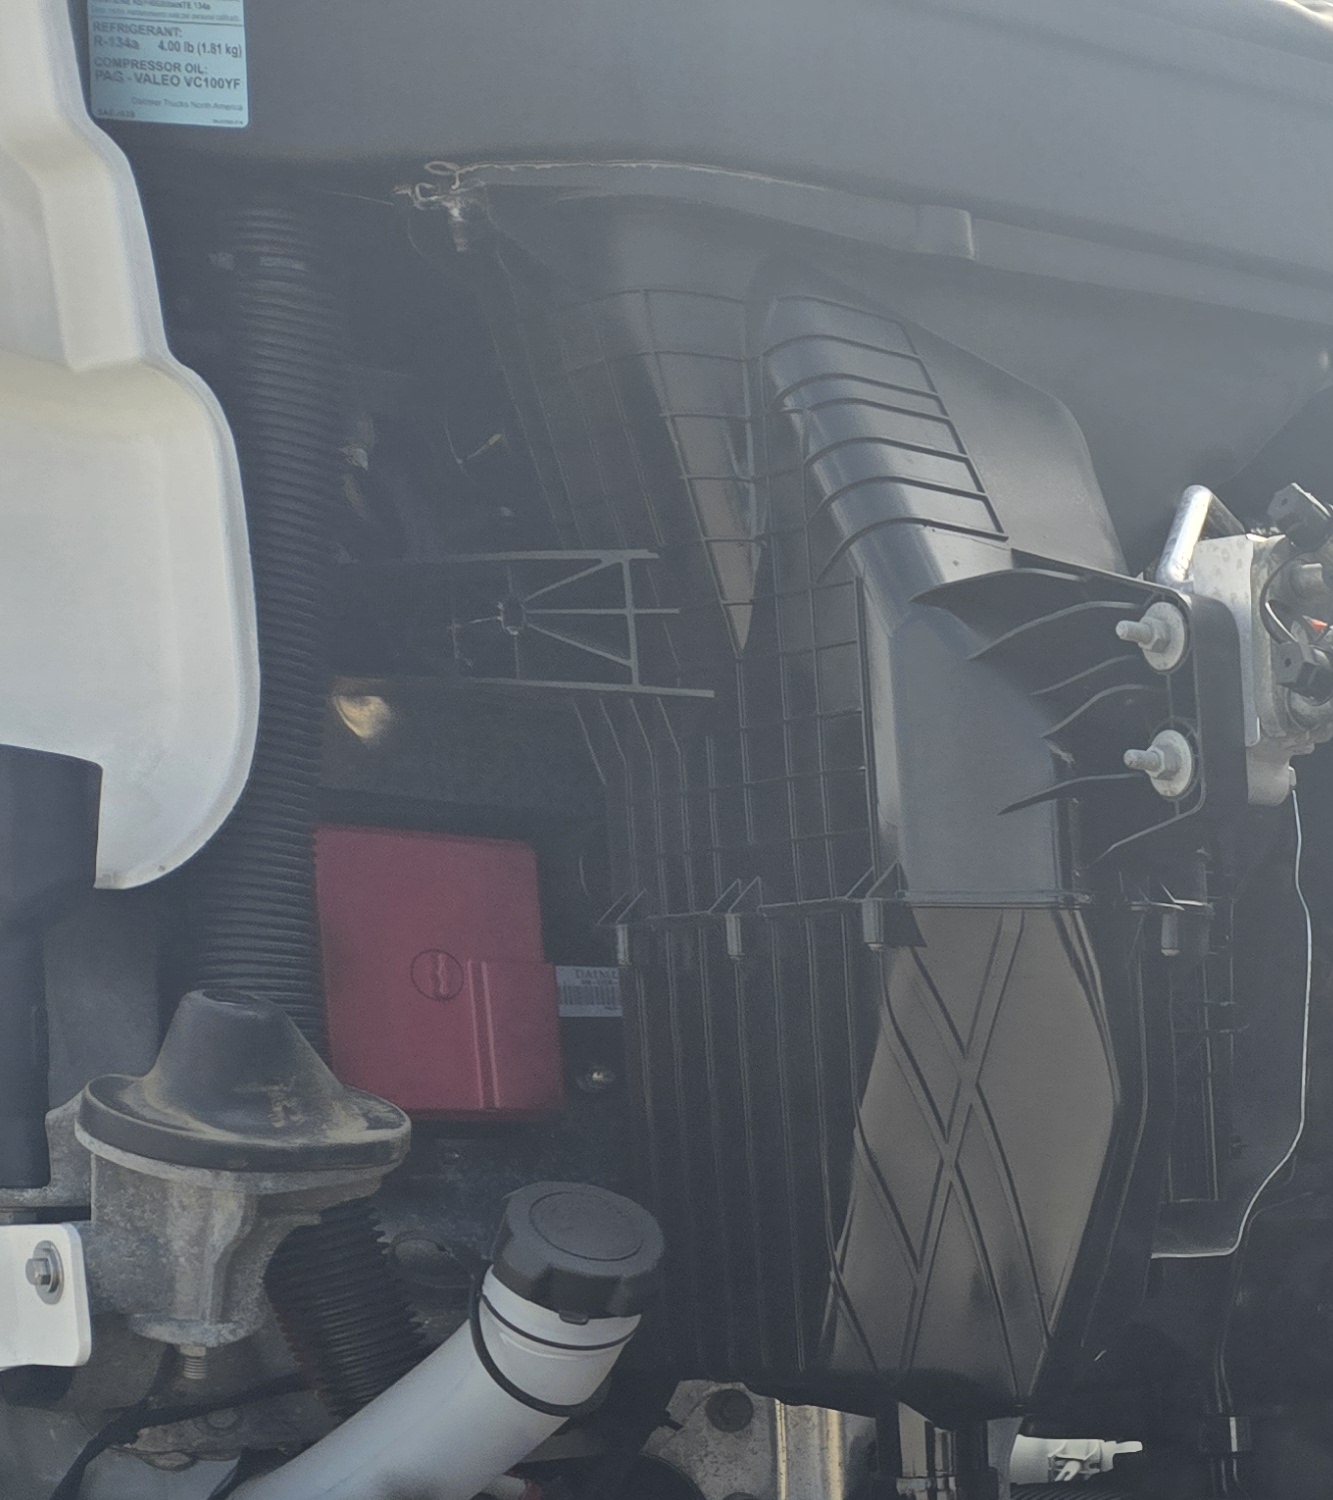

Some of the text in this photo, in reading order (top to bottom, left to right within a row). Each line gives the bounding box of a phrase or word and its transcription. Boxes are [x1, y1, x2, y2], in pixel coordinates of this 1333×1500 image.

[92, 22, 183, 38] REFRIGERANT:
[93, 35, 242, 58] R-134a 4.00 lb (1.81 kg)
[94, 57, 207, 75] COMPRESSOR OIL:
[95, 70, 124, 84] PAG
[135, 72, 180, 87] VALEO
[185, 77, 240, 90] VC100YF
